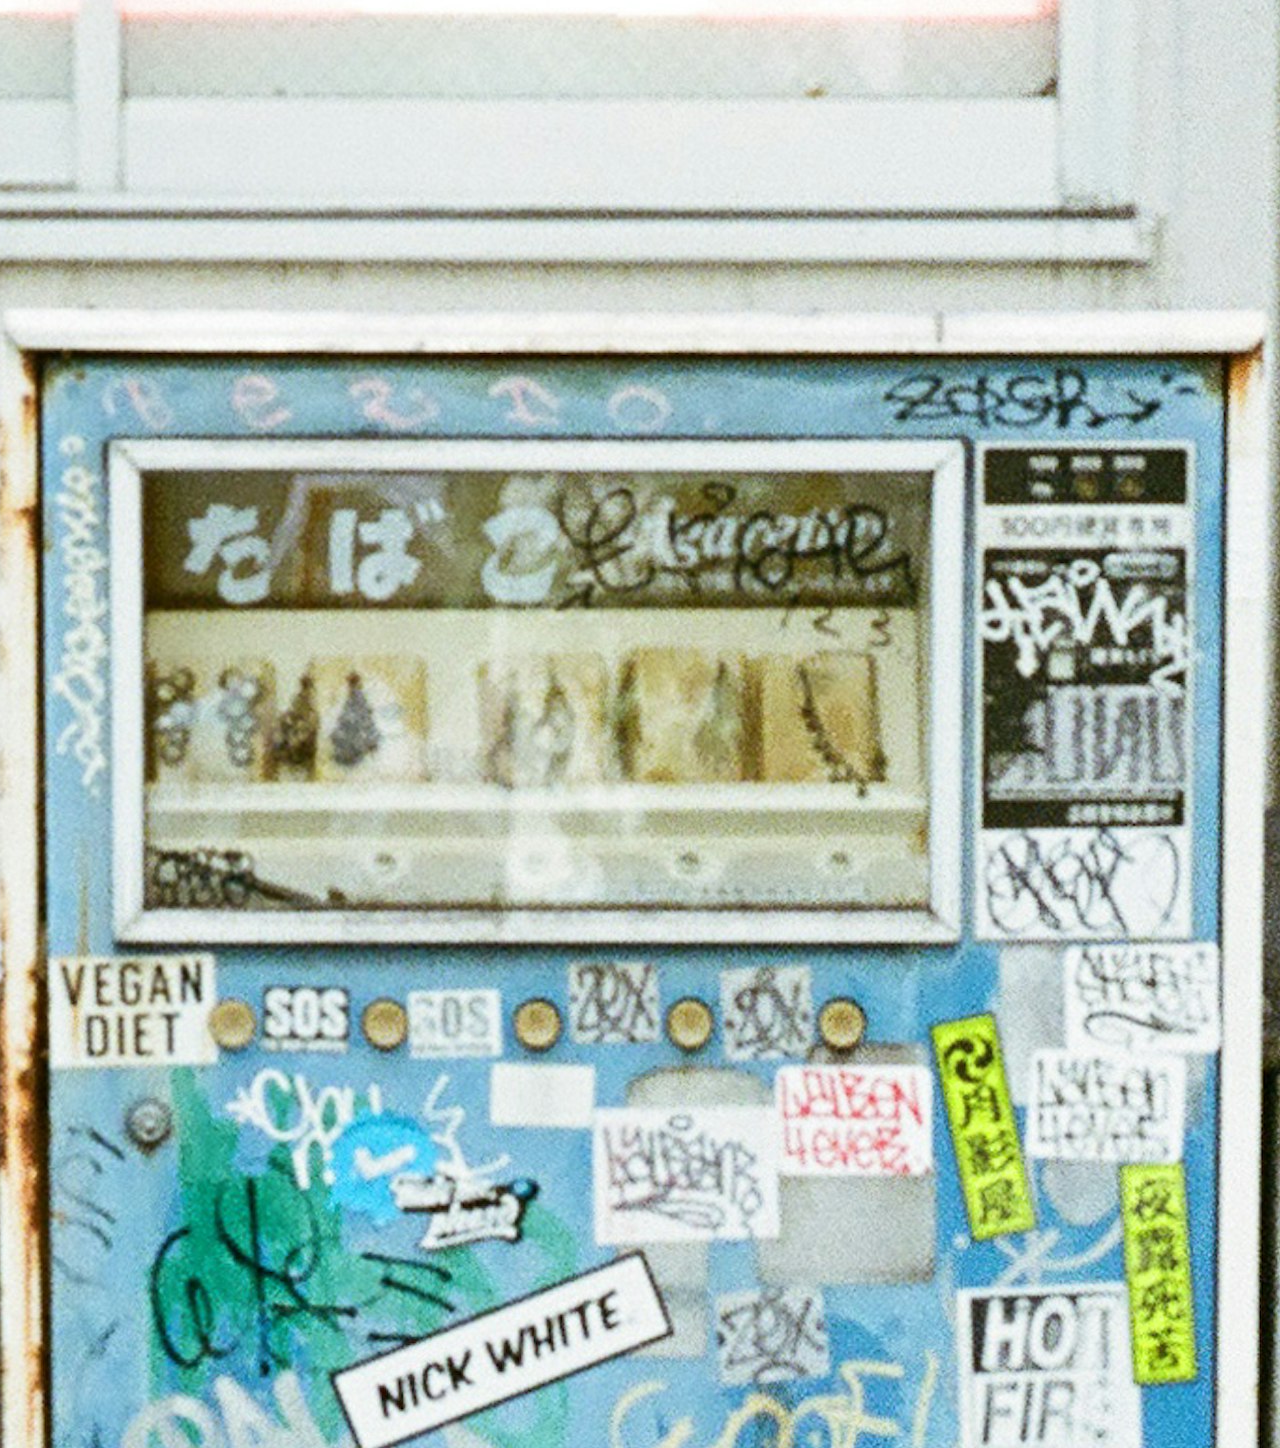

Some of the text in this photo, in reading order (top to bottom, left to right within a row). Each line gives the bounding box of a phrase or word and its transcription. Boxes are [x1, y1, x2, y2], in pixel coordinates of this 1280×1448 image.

[182, 498, 561, 605] たばこ
[60, 961, 202, 1006] VEGAN
[265, 988, 348, 1038] SOS
[86, 1012, 179, 1057] DIET
[960, 1083, 1018, 1225] 月影屋
[1132, 1176, 1181, 1370] 夜露死苦
[377, 1289, 620, 1418] NICK WHITE
[982, 1380, 1112, 1445] FIR
